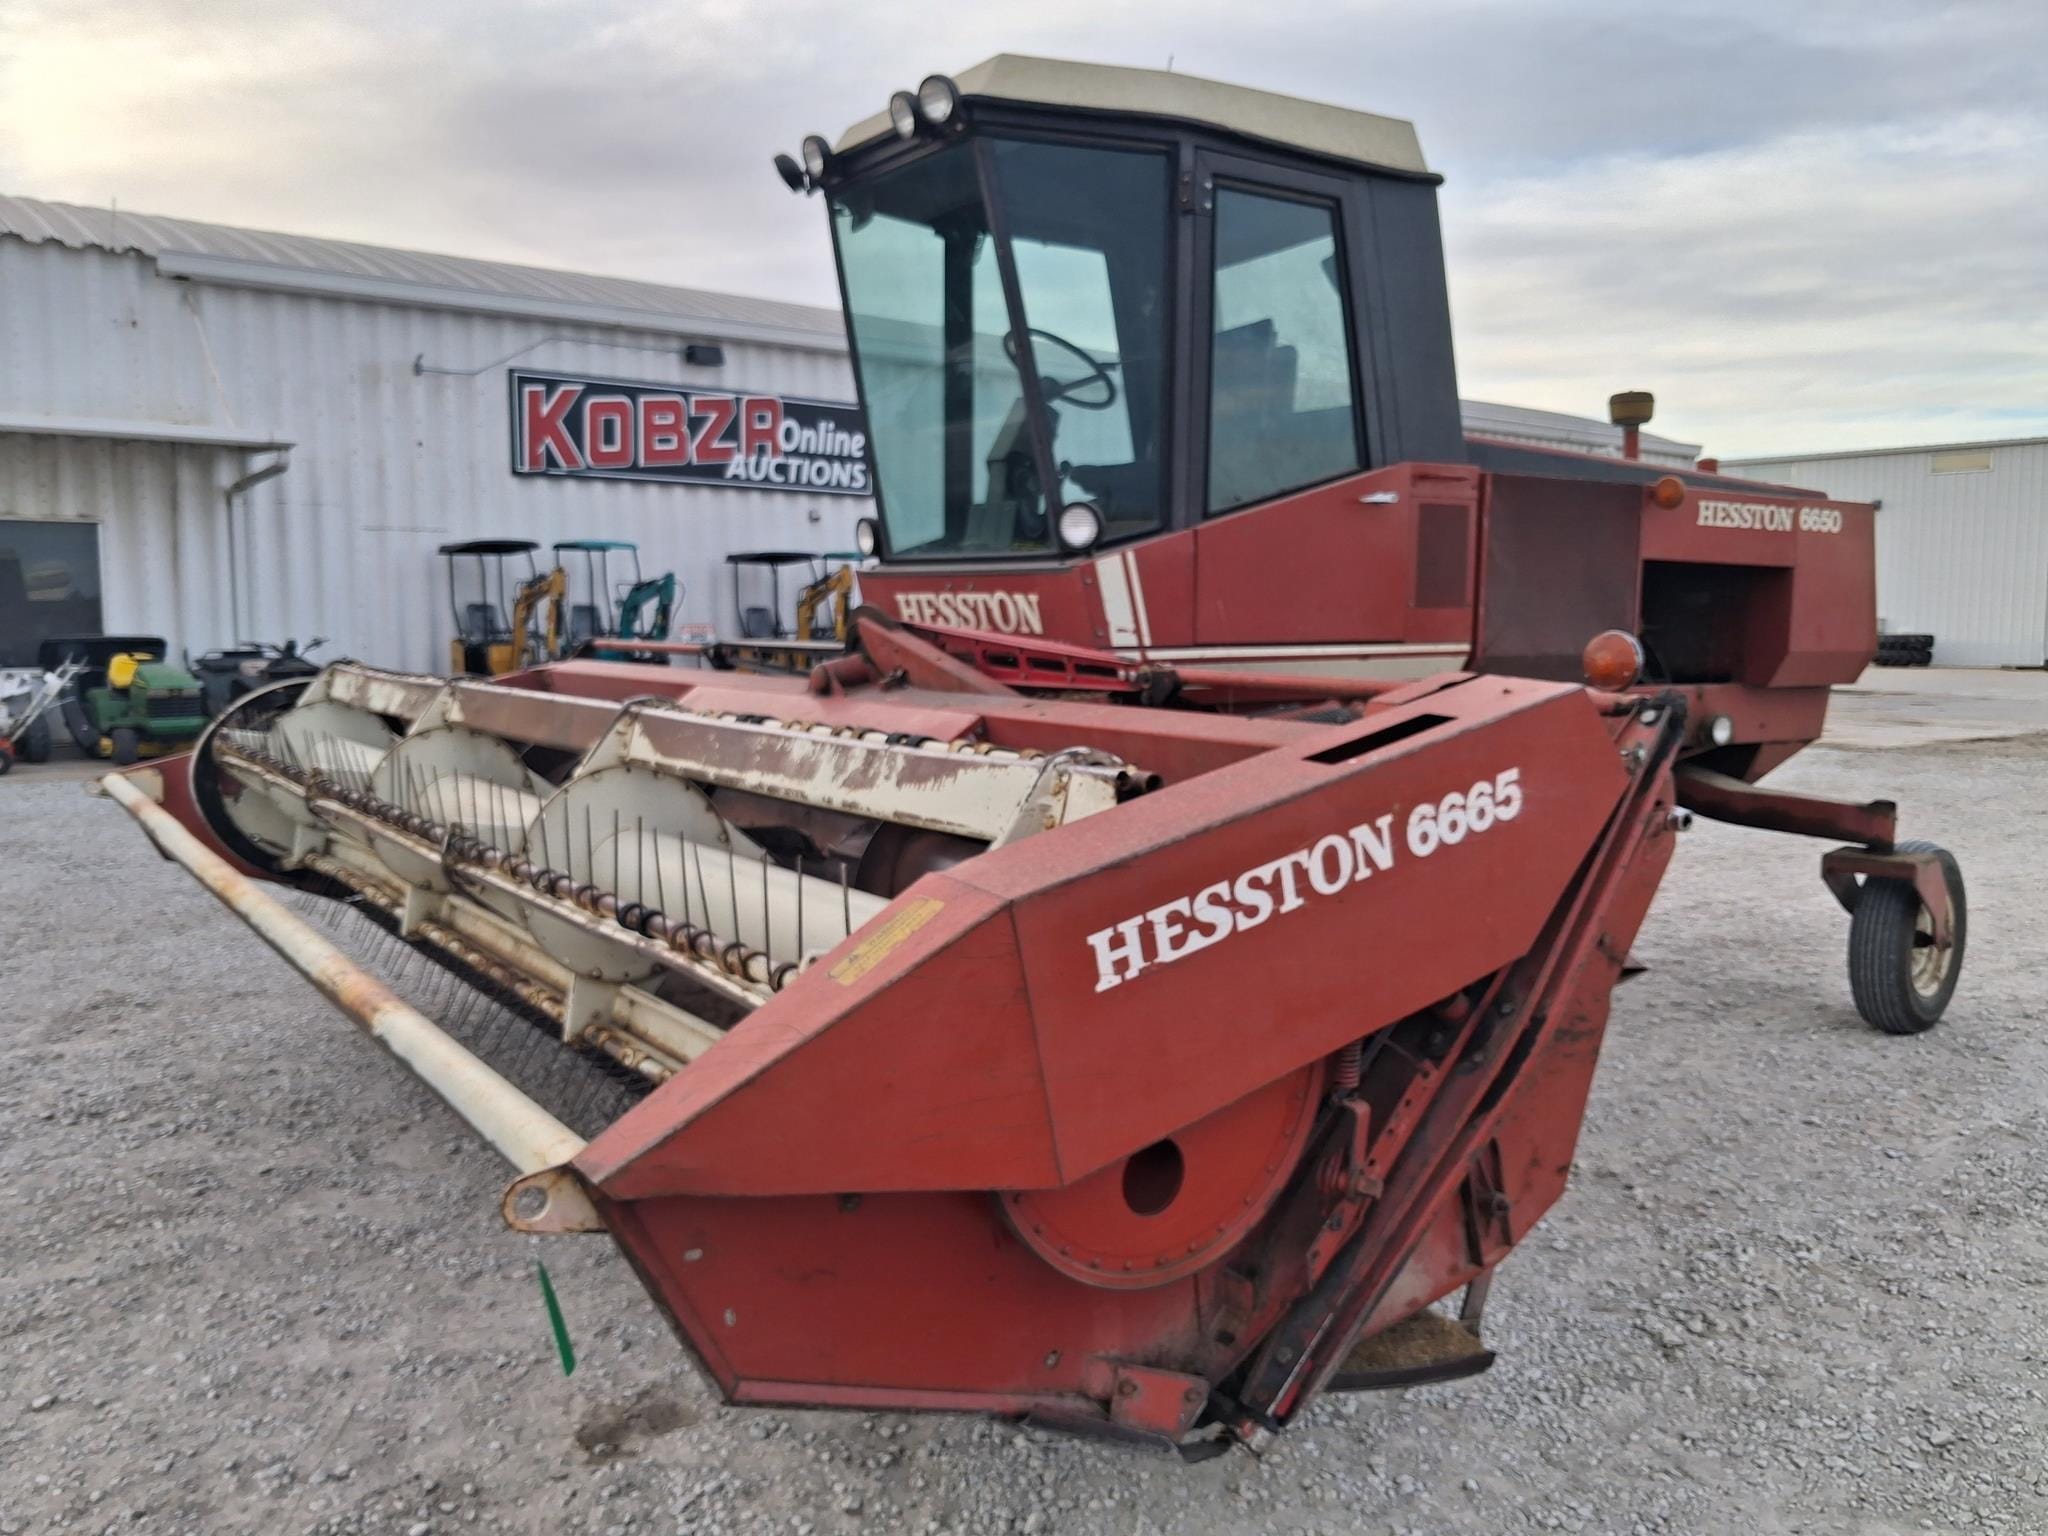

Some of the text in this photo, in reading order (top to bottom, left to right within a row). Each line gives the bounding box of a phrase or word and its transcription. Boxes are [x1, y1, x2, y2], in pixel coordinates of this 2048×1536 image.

[522, 383, 784, 474] KOBZA
[779, 417, 866, 458] Online
[724, 454, 868, 489] AUCTIONS
[1696, 501, 1843, 534] HESSTON 6650
[895, 590, 1044, 635] HESSTON
[1087, 814, 1395, 993] HESSTON
[1407, 767, 1523, 857] 6665
